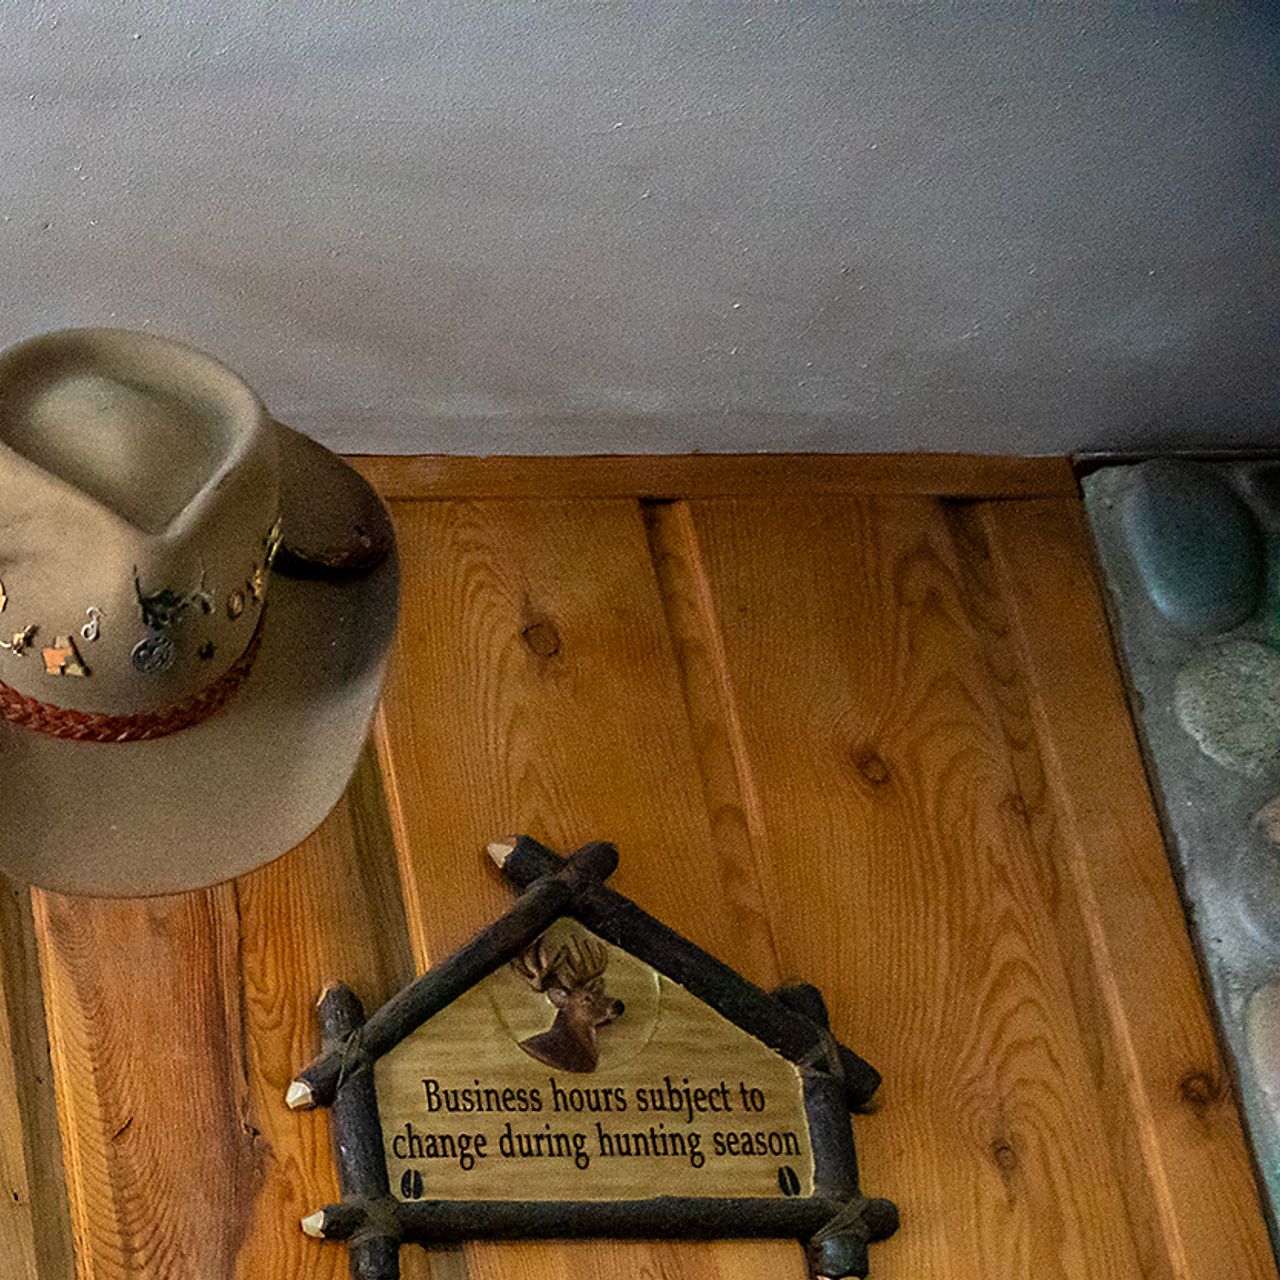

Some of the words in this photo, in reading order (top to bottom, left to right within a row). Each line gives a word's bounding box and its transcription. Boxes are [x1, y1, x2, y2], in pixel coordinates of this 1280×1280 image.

[421, 1078, 543, 1112] Business
[549, 1077, 627, 1112] hours
[636, 1076, 734, 1124] subject
[740, 1081, 766, 1112] to
[392, 1122, 488, 1171] change
[499, 1122, 590, 1170] during
[595, 1121, 706, 1169] hunting
[713, 1127, 801, 1157] season
